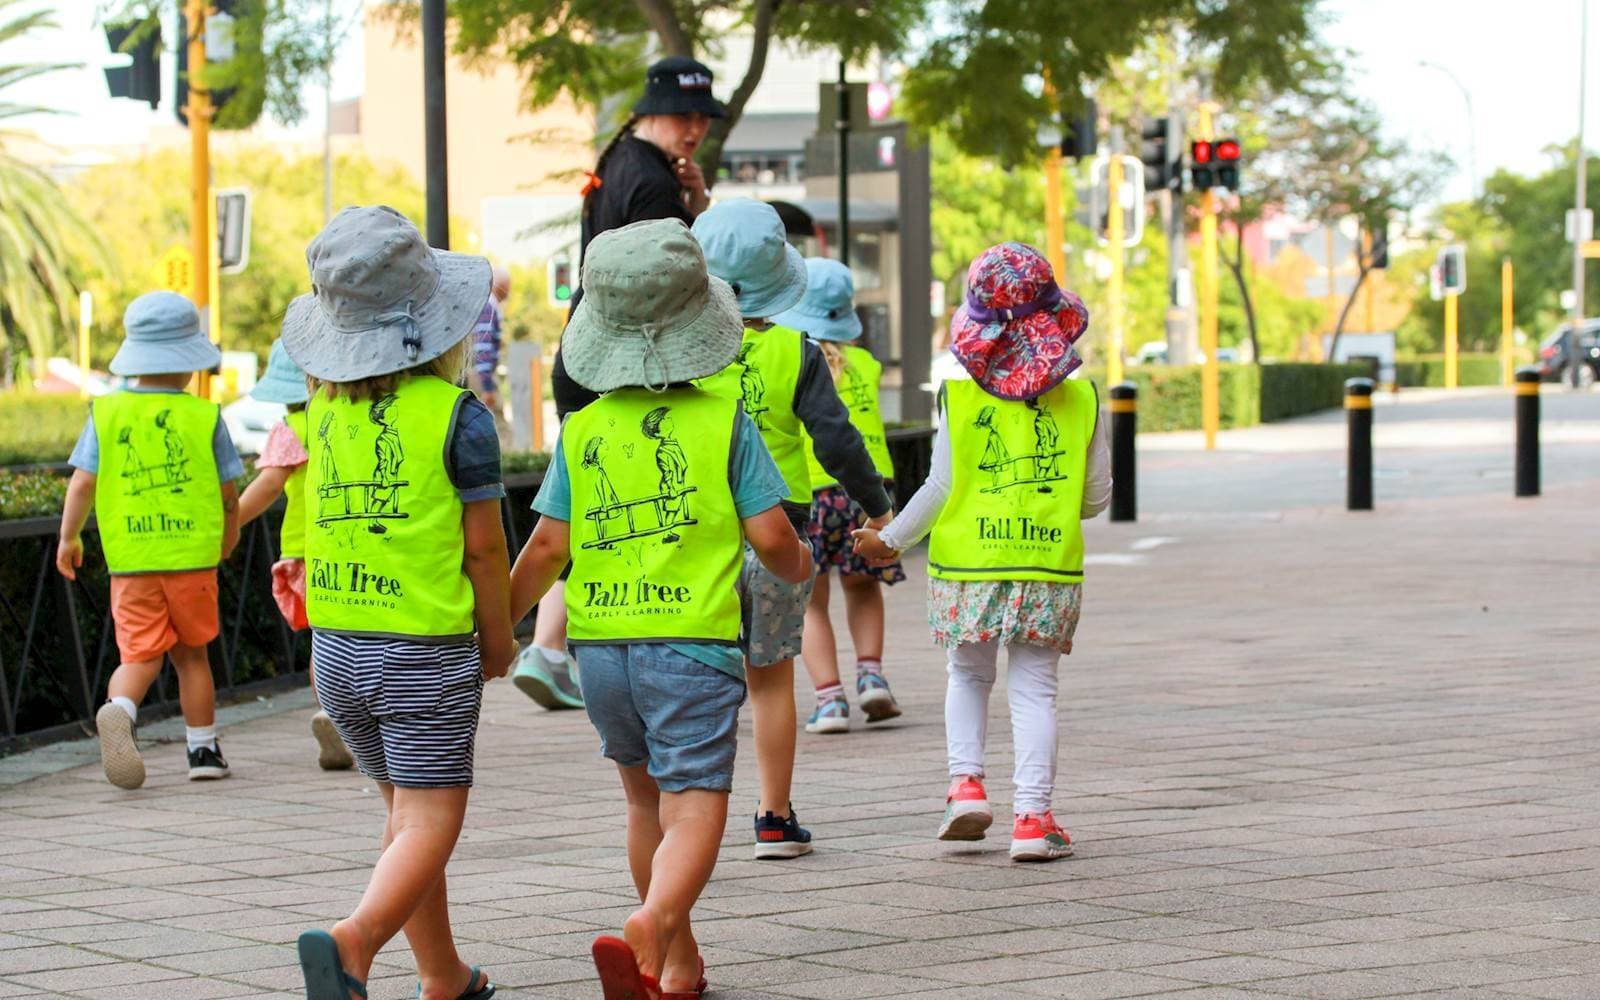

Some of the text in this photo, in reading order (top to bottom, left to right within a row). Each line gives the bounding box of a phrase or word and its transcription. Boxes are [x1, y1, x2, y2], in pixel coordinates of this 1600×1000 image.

[124, 513, 195, 533] Tall Tree
[976, 517, 1062, 543] Tall Tree
[311, 558, 403, 597] Tall Tree
[342, 597, 396, 609] LEARNING
[583, 582, 629, 607] Tall
[588, 607, 683, 619] EARLY LEARNING
